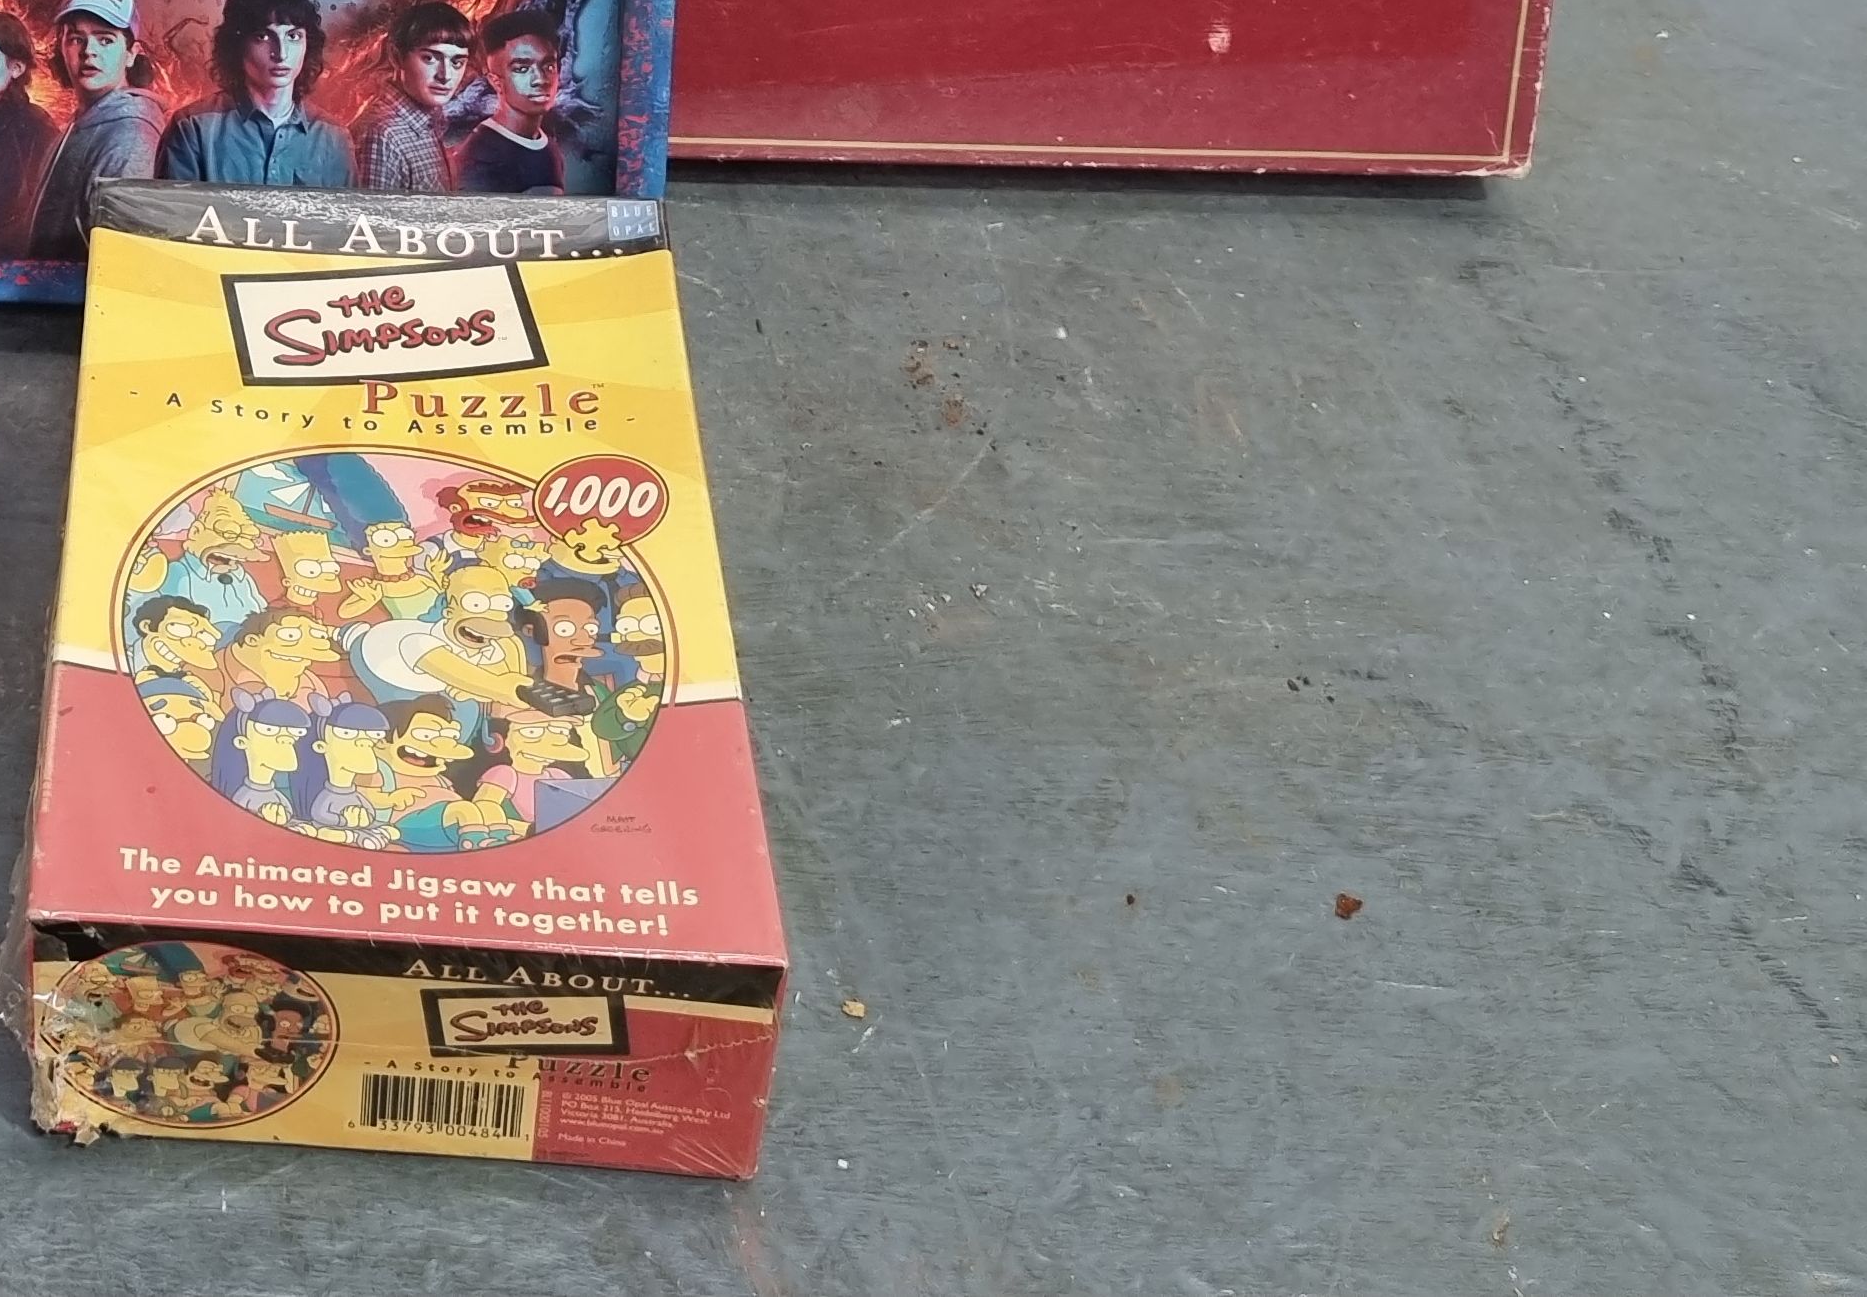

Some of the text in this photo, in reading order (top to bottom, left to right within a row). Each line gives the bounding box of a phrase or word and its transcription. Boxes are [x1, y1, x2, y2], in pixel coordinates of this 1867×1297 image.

[186, 205, 313, 251] ALL
[610, 204, 654, 218] BLUE
[611, 222, 657, 237] OPAL
[264, 308, 496, 367] SIMPSONS
[166, 392, 599, 437] A Story to Assemble
[358, 379, 602, 418] Puzzle
[540, 473, 660, 518] 1,000
[119, 847, 699, 907] The Animated Jigsaw that tells
[150, 884, 669, 937] you how to put it together!
[402, 958, 487, 983] ALL
[450, 1009, 599, 1043] SIMPSONS
[385, 1059, 398, 1070] A
[413, 1060, 479, 1078] Story
[493, 1068, 516, 1080] to
